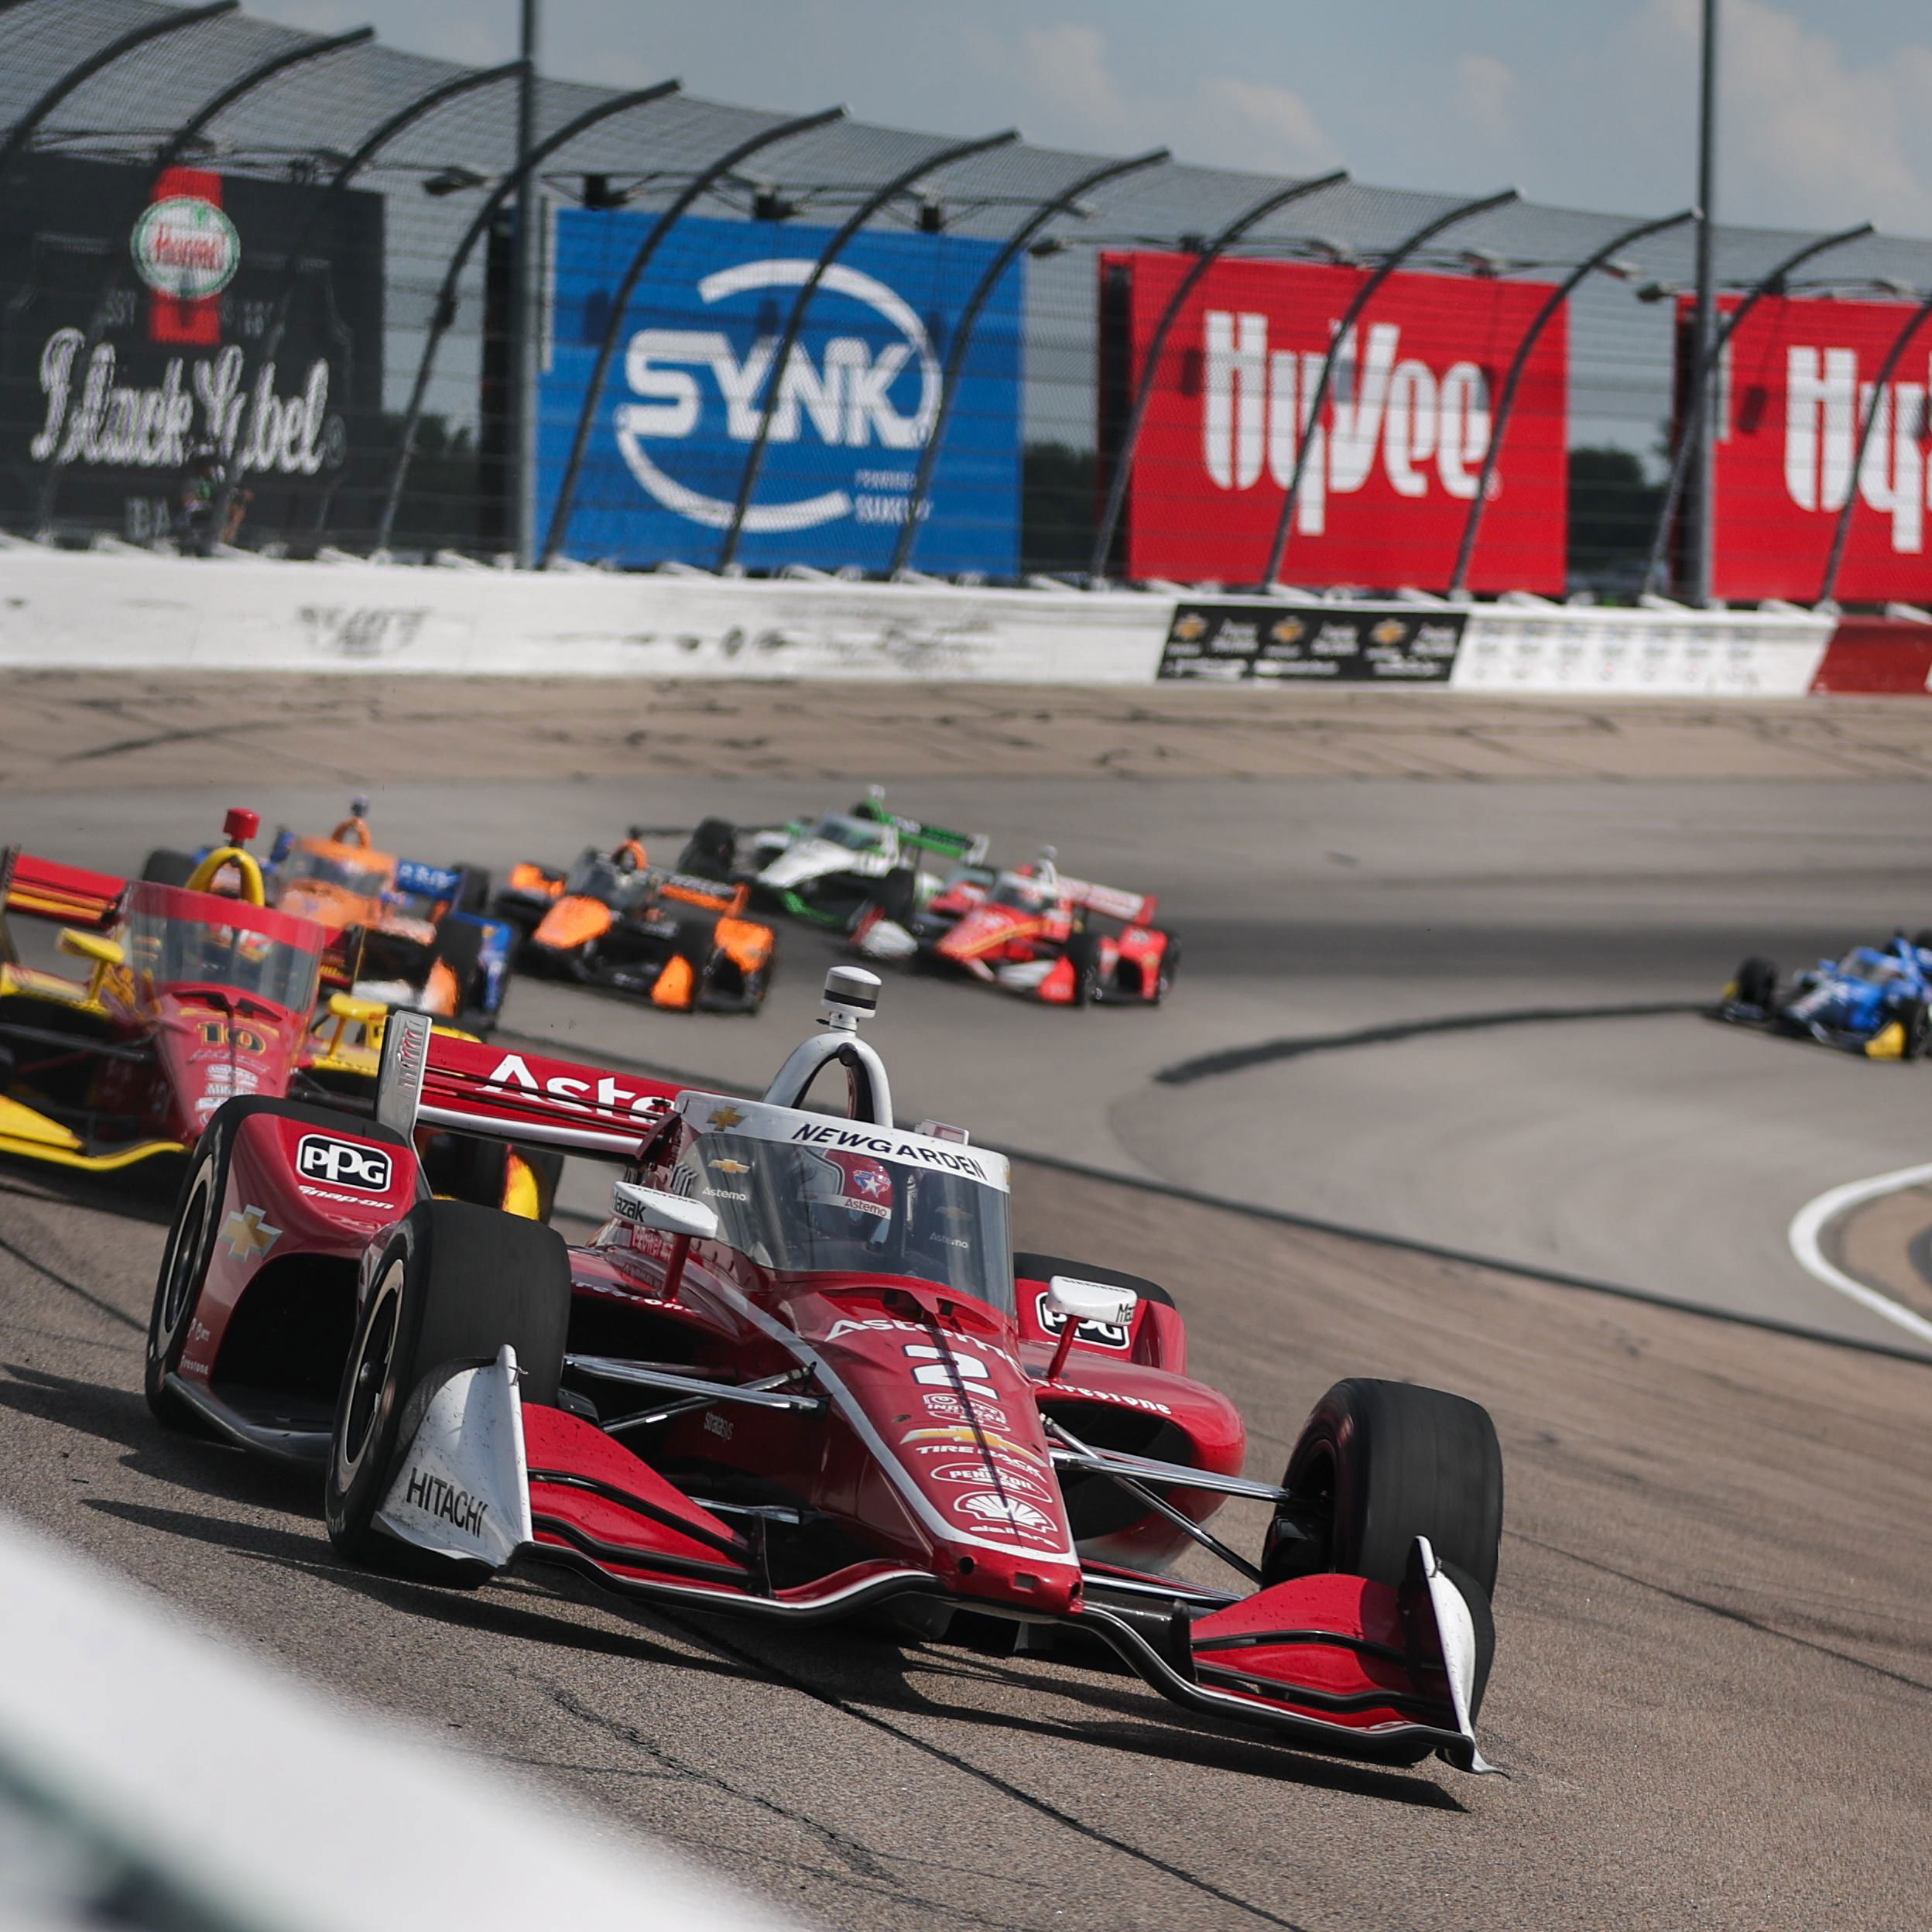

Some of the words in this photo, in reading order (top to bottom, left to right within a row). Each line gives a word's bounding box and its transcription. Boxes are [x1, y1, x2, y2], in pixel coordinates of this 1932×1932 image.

[625, 328, 932, 449] SYNK
[1784, 345, 1932, 553] Hy
[303, 1144, 385, 1185] PPG
[791, 1123, 988, 1181] NEWGARDEN
[615, 1192, 646, 1223] azak
[702, 1187, 747, 1201] Astemo
[844, 1198, 887, 1218] Astemo
[929, 1232, 969, 1249] Astemo
[903, 1344, 999, 1400] 2
[1032, 1378, 1172, 1415] Firestone
[916, 1444, 975, 1454] TIRE
[406, 1466, 489, 1538] HITACHI
